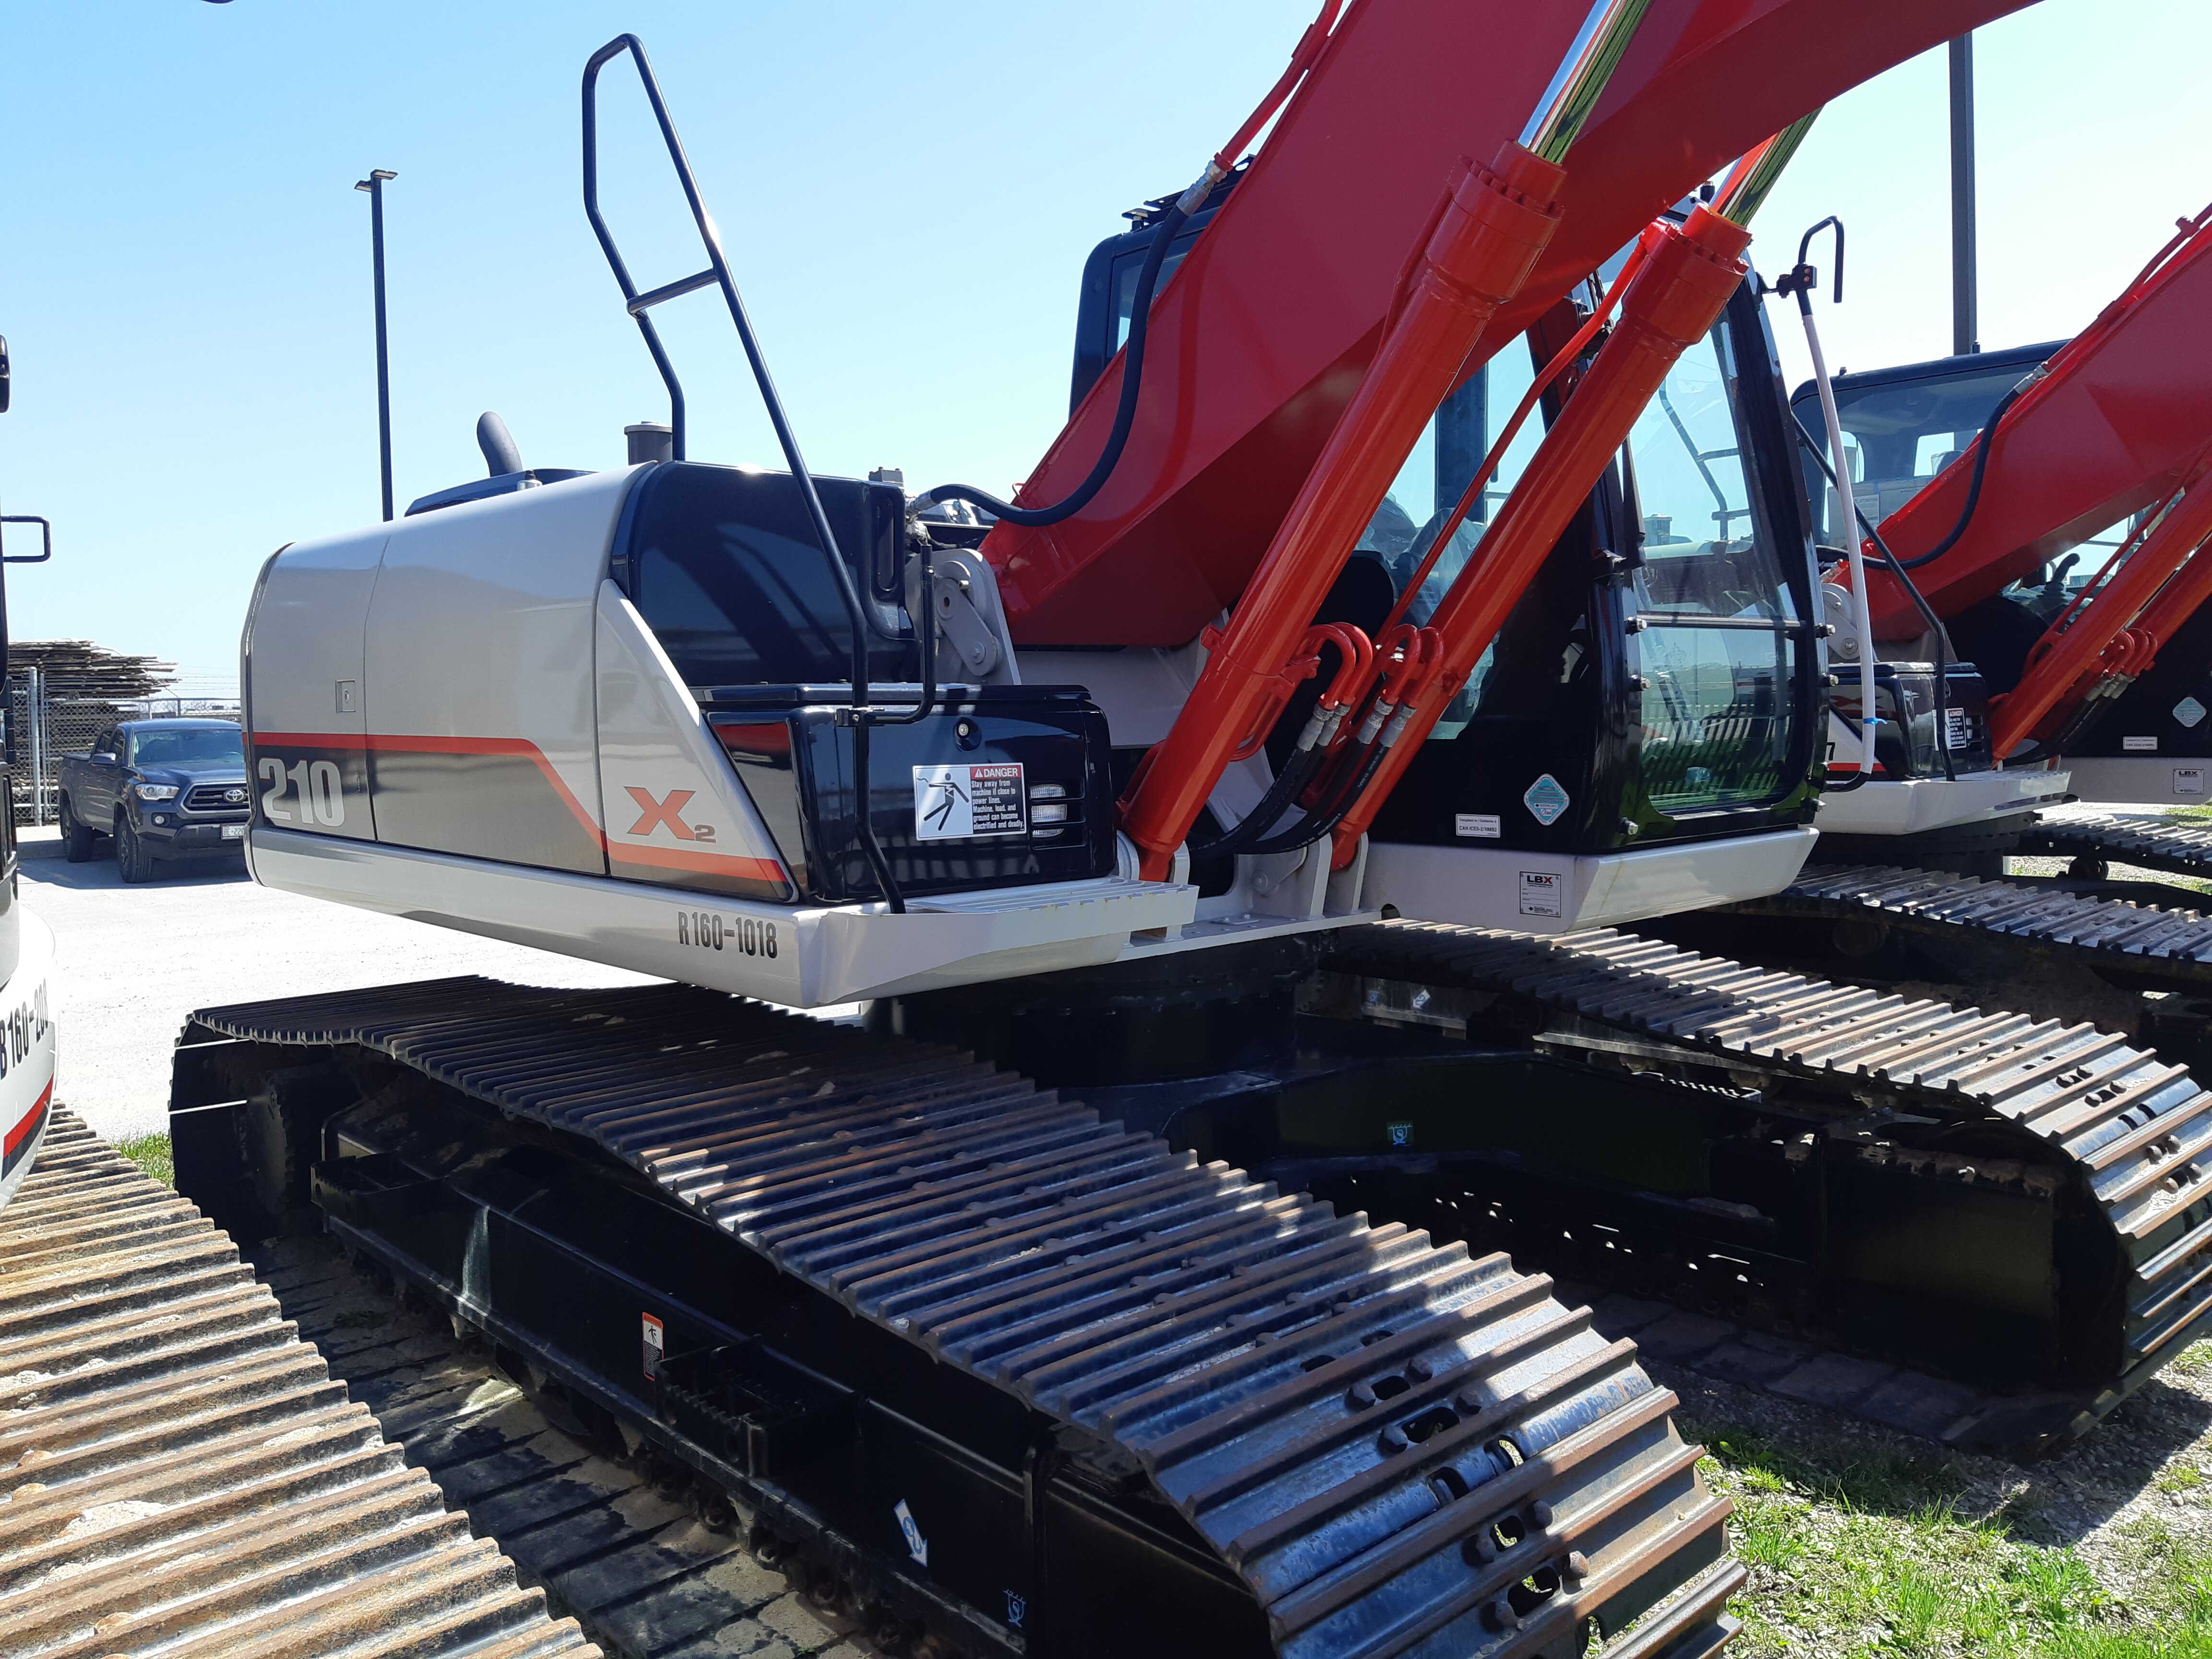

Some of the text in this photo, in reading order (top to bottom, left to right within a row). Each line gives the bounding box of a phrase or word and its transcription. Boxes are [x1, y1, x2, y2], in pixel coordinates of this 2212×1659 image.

[984, 768, 1018, 777] DANGER
[259, 758, 345, 826] 210
[974, 814, 989, 822] ground
[974, 821, 997, 830] electrified
[1527, 875, 1553, 884] LBX
[678, 911, 778, 959] R160-1018
